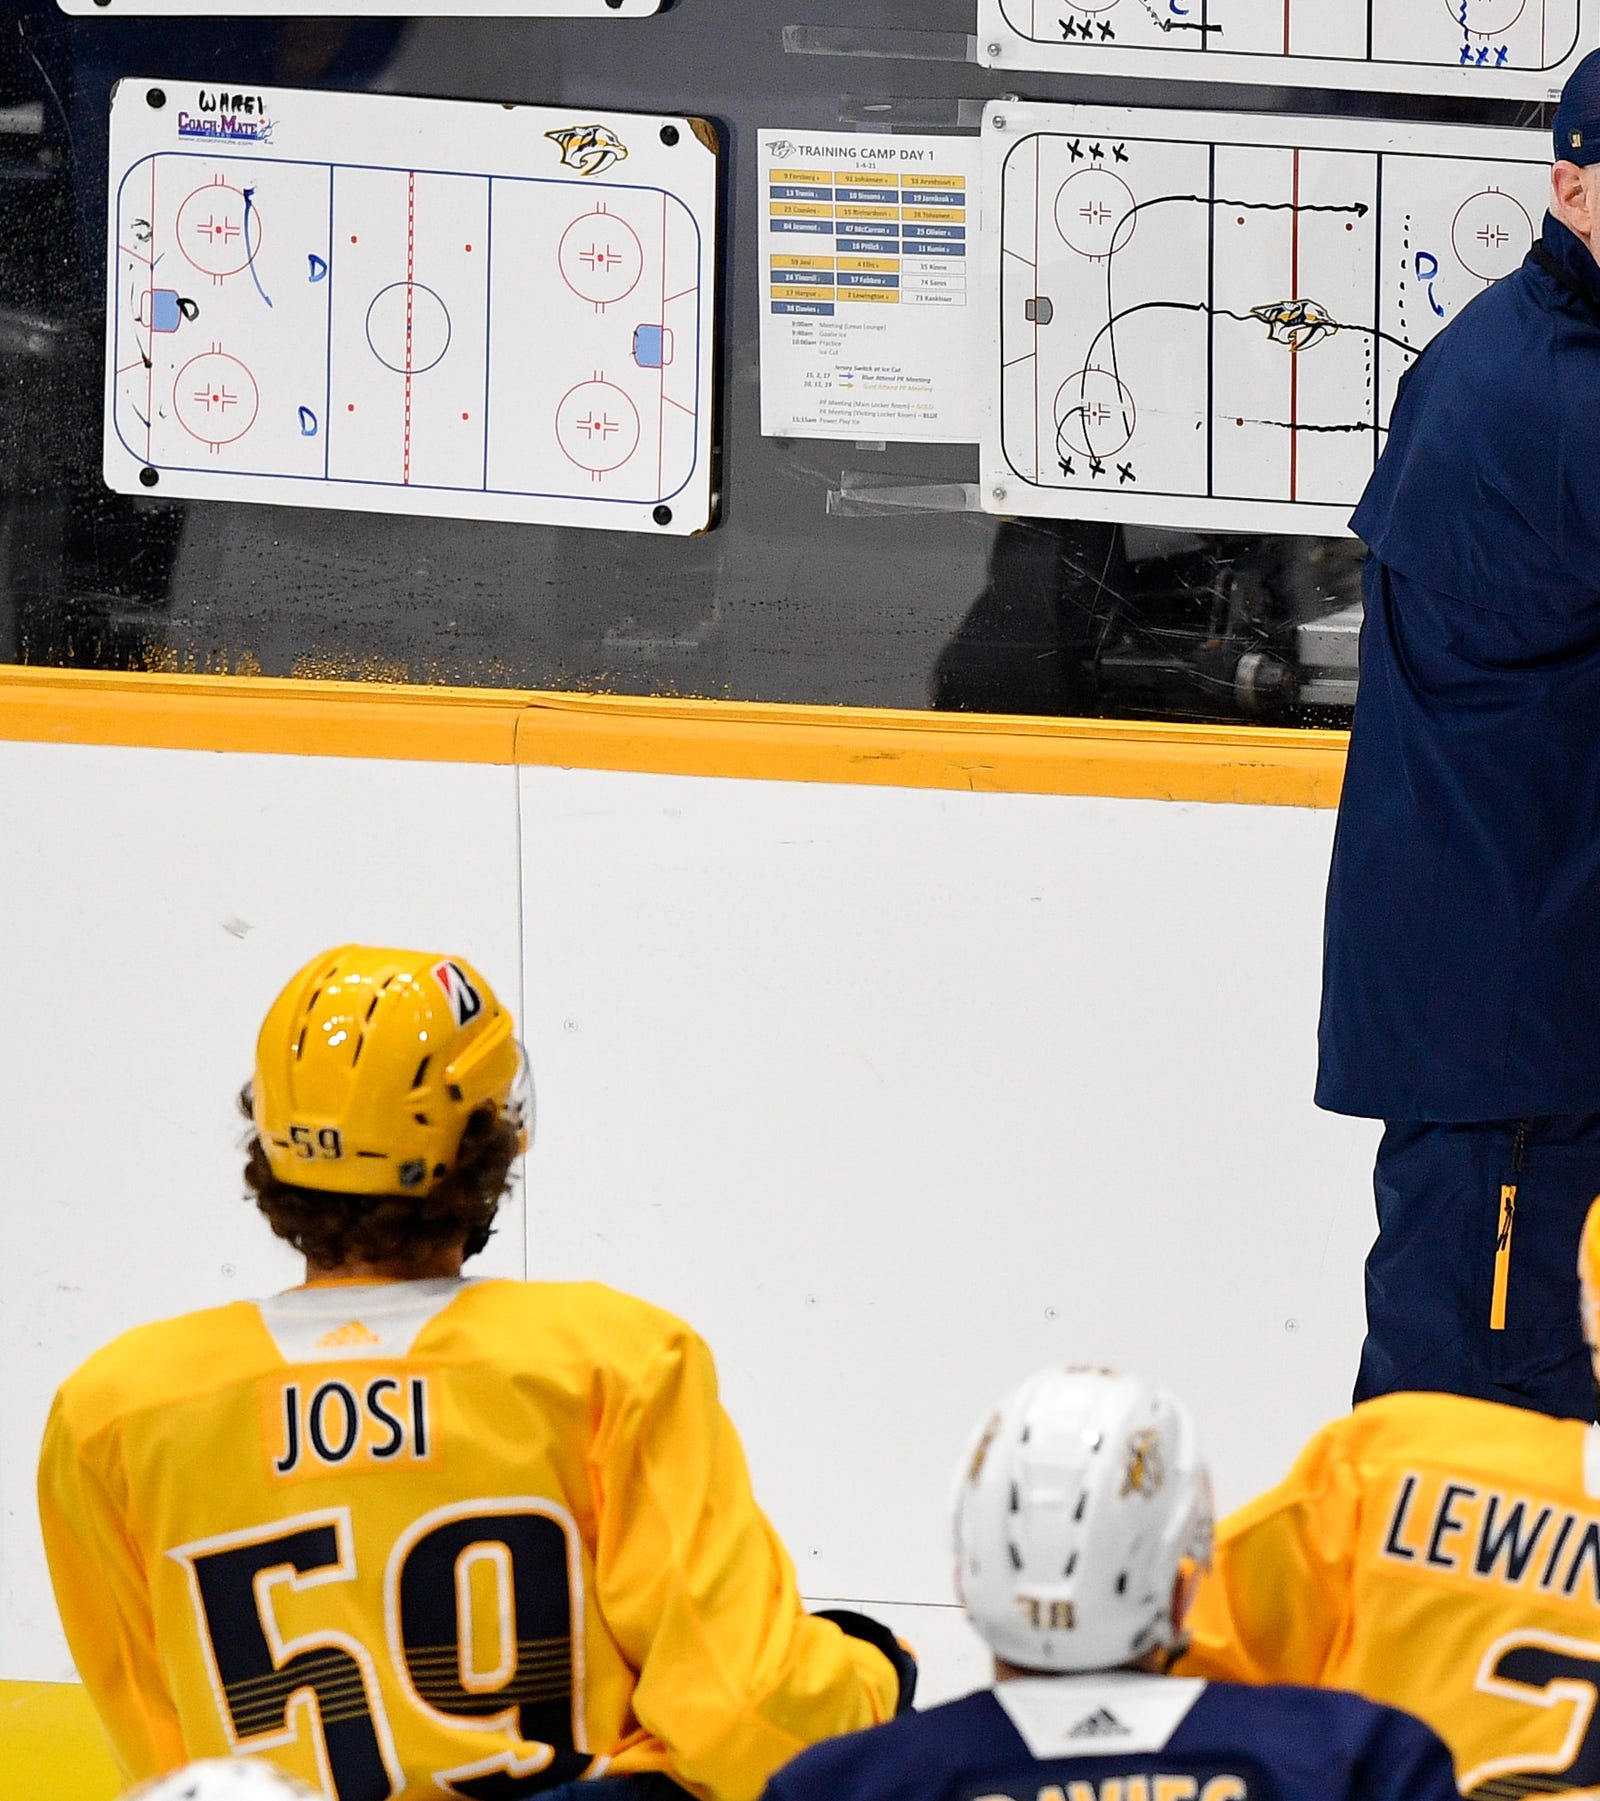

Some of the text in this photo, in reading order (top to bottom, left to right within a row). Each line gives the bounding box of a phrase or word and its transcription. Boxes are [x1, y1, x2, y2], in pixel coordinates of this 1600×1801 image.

[798, 145, 934, 160] TRAINING CAMP DAY 1
[290, 1124, 342, 1160] 59
[275, 1377, 430, 1474] JOSI
[167, 1496, 605, 1801] 59
